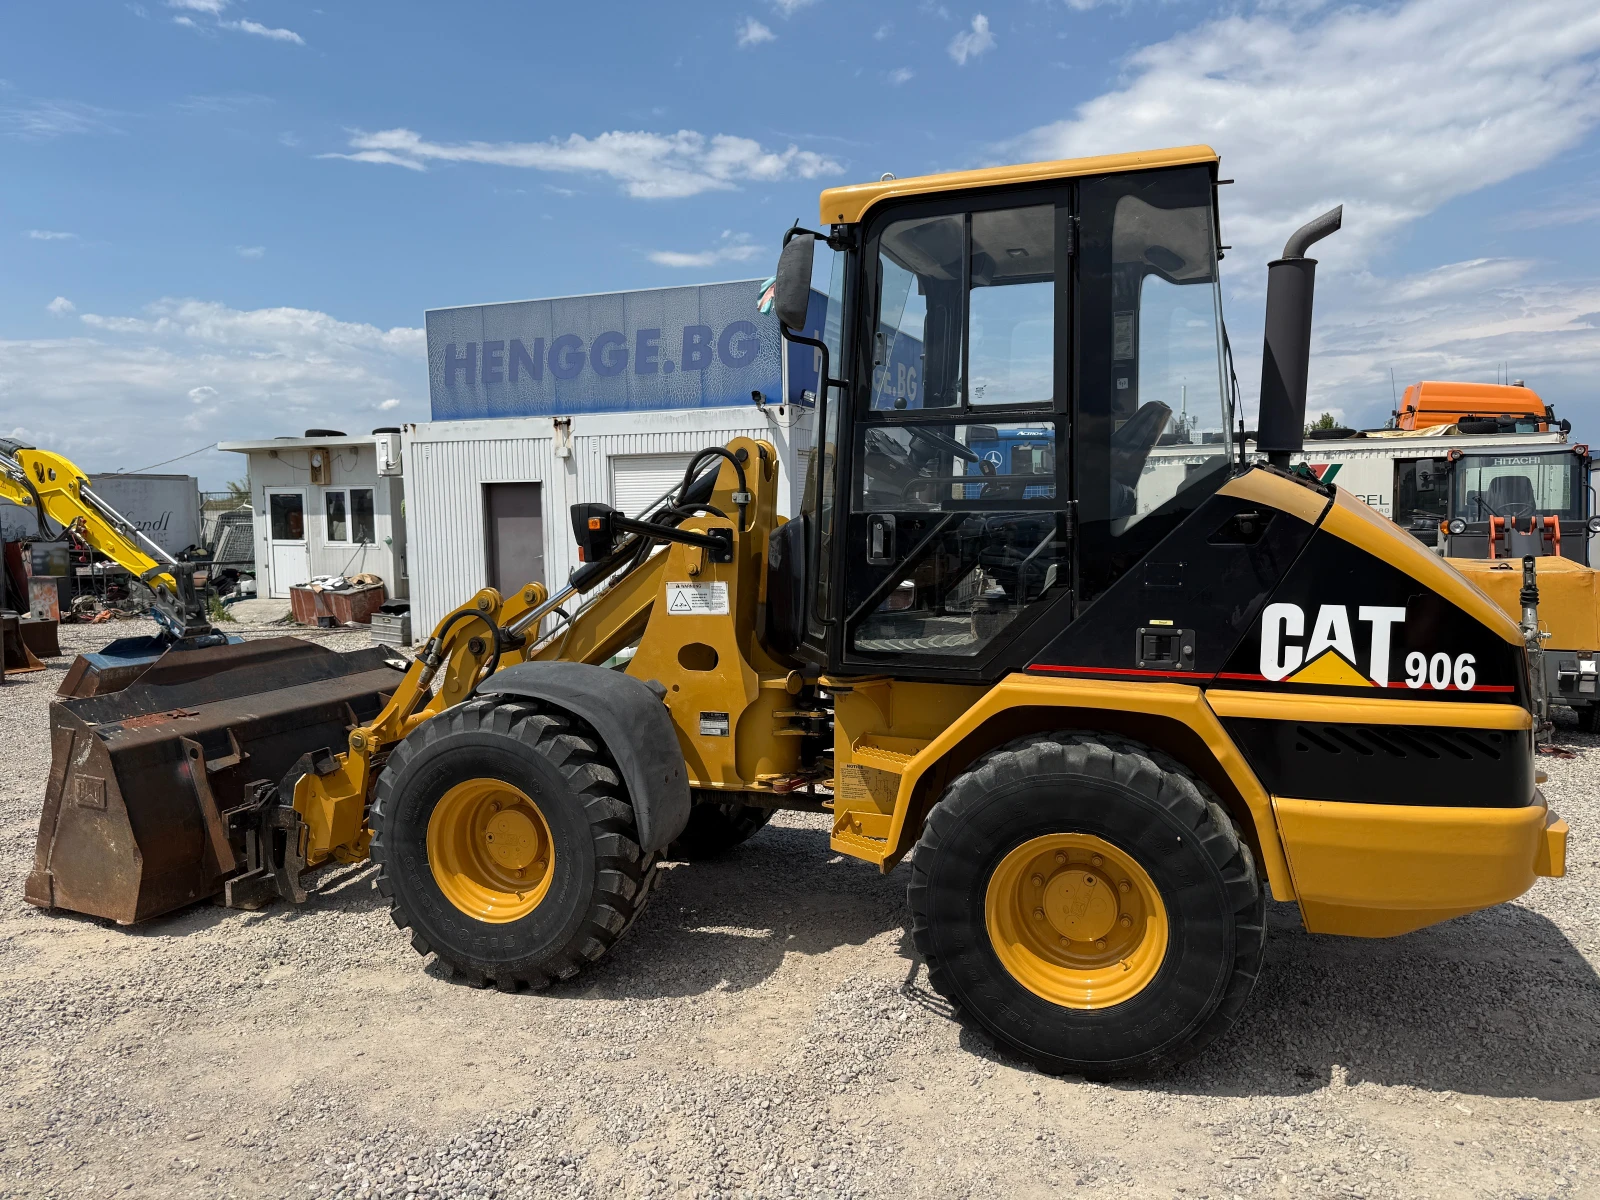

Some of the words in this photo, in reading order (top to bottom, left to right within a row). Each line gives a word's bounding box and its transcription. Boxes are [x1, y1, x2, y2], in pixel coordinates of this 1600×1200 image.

[444, 320, 760, 387] HENGGE.BG
[1494, 456, 1540, 466] HITACHI
[1259, 602, 1407, 688] CAT
[1405, 651, 1476, 691] 906
